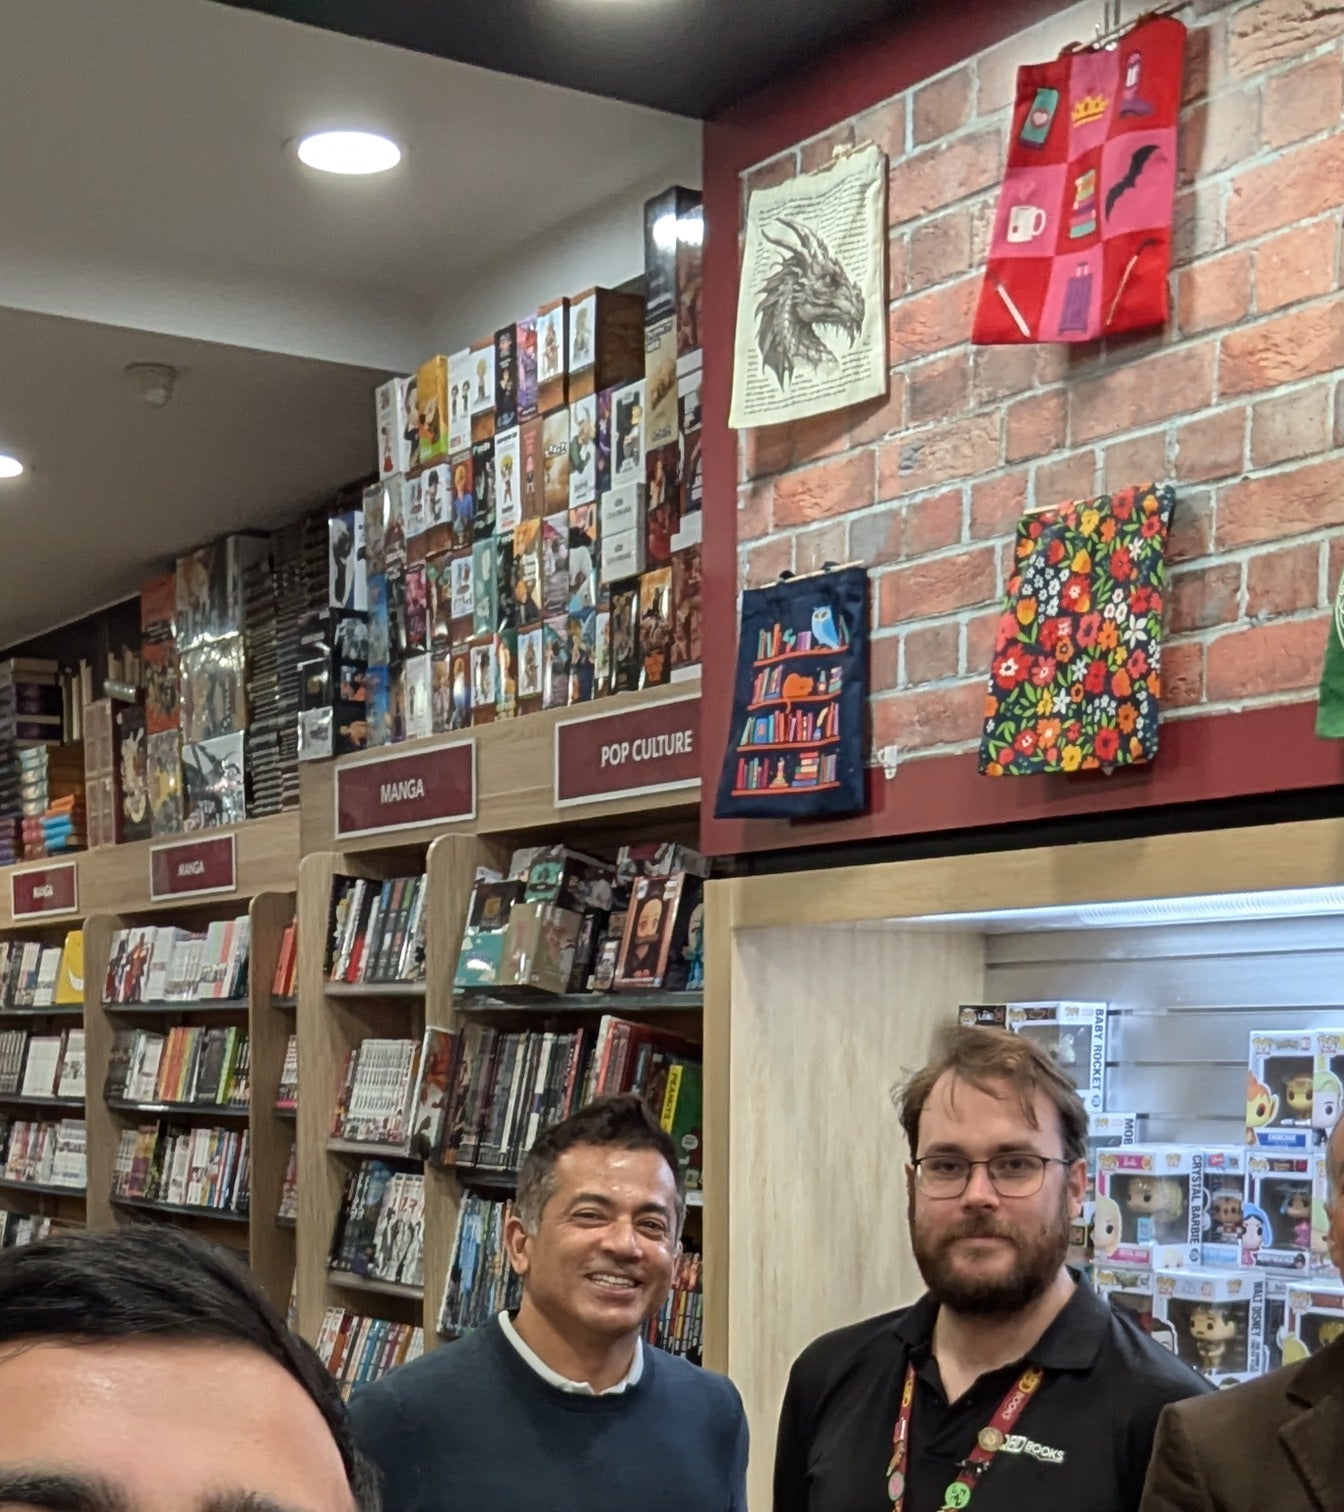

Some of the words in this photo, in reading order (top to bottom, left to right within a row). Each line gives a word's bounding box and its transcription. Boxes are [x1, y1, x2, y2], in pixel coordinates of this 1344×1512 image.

[600, 744, 630, 768] POP
[632, 730, 694, 761] CULTURE
[380, 777, 425, 804] MANGA
[177, 860, 206, 877] MANGA
[1094, 1008, 1104, 1041] BABY
[1092, 1044, 1104, 1090] ROCKET
[1190, 1154, 1203, 1202] CRYSTAL
[1188, 1205, 1201, 1246] BARBIE
[1025, 1441, 1065, 1462] BOOKS
